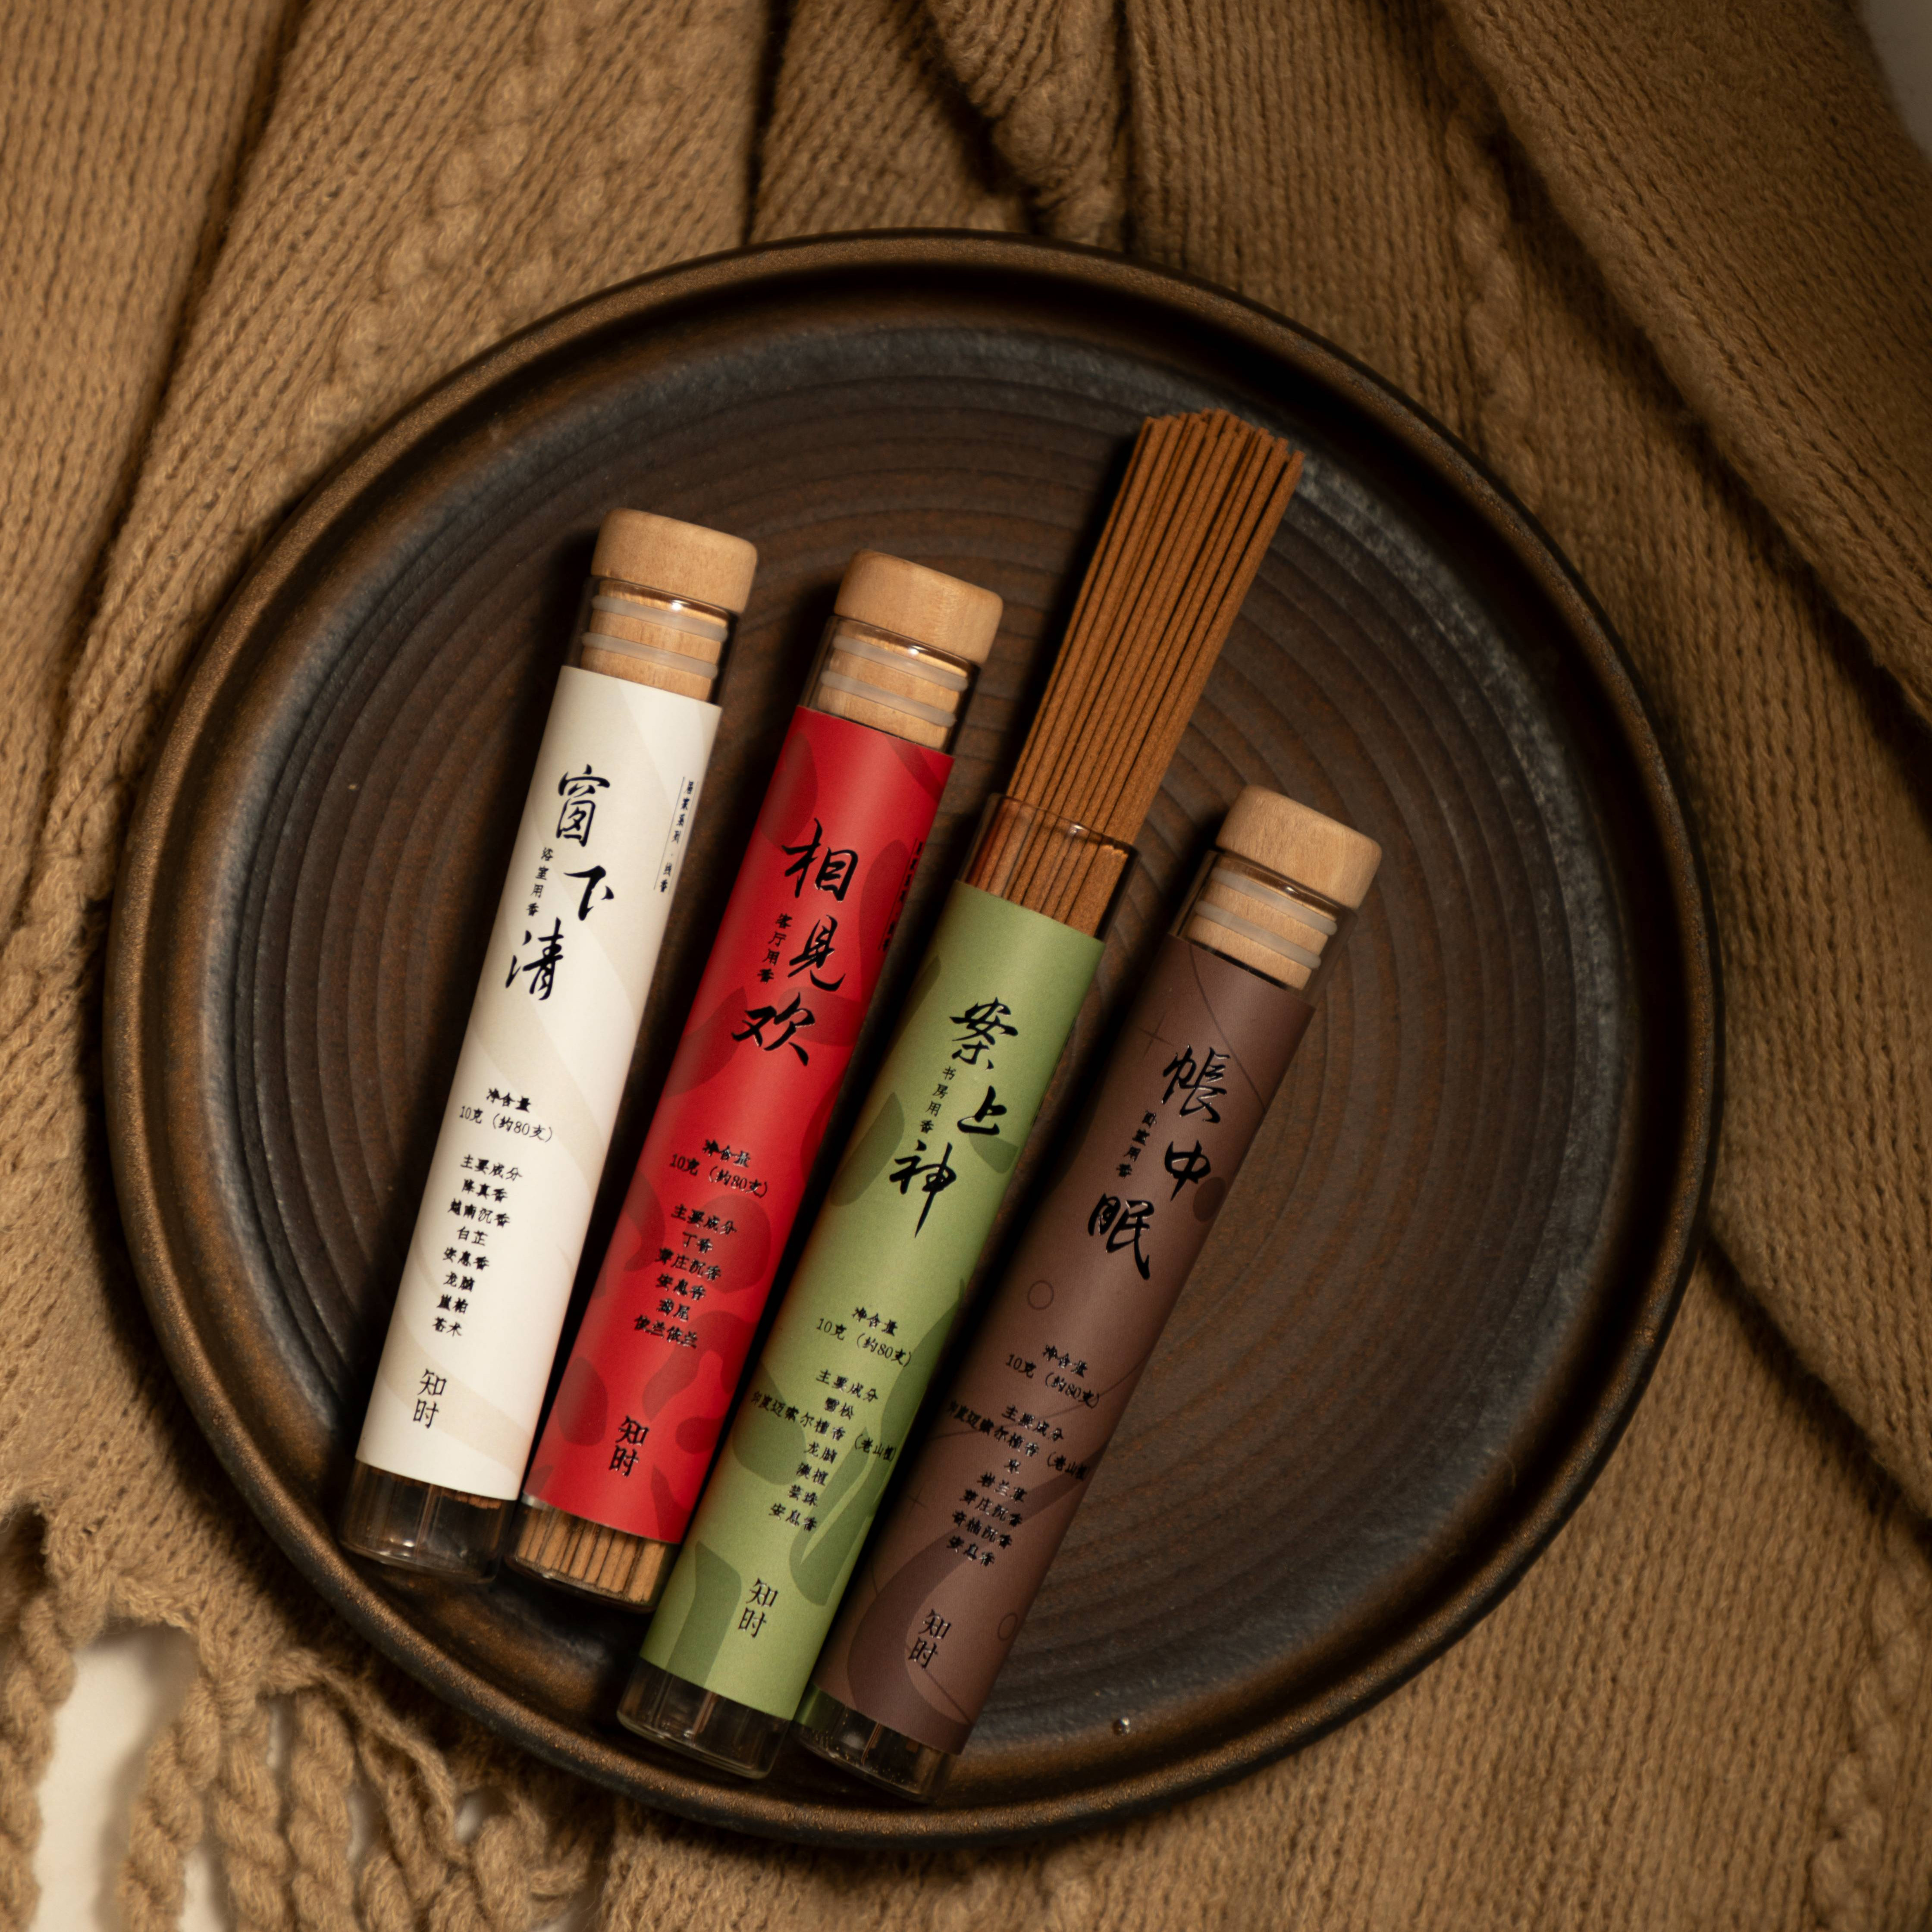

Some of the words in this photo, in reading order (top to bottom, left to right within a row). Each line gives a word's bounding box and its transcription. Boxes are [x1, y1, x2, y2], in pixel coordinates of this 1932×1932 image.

[506, 764, 614, 1000] 窗下清
[526, 847, 554, 916] 浴室用香
[731, 818, 858, 1066] 相见欢
[757, 913, 793, 984] 客厅用香
[486, 1088, 531, 1113] 净含量
[919, 1066, 956, 1134] 书房用香
[889, 997, 1018, 1239] 案上神
[460, 1154, 523, 1182] 主要成分
[702, 1139, 750, 1168] 净含量
[448, 1198, 510, 1228] 越南沉香
[671, 1204, 737, 1236] 主要成分
[457, 1226, 489, 1246] 白芷
[682, 1231, 713, 1254] 丁香
[442, 1247, 490, 1270] 安息香
[443, 1271, 476, 1292] 龙脑
[655, 1273, 706, 1302] 安息香
[852, 1306, 899, 1337] 净含量
[1042, 1344, 1088, 1378] 净含量
[413, 1368, 447, 1429] 知时
[815, 1369, 879, 1402] 主要成分
[1001, 1404, 1064, 1443] 主要成分
[608, 1414, 649, 1477] 知时
[803, 1441, 838, 1464] 龙脑
[768, 1502, 818, 1531] 安息香
[947, 1534, 995, 1568] 安息香
[738, 1578, 778, 1638] 知时
[908, 1608, 952, 1670] 知时
